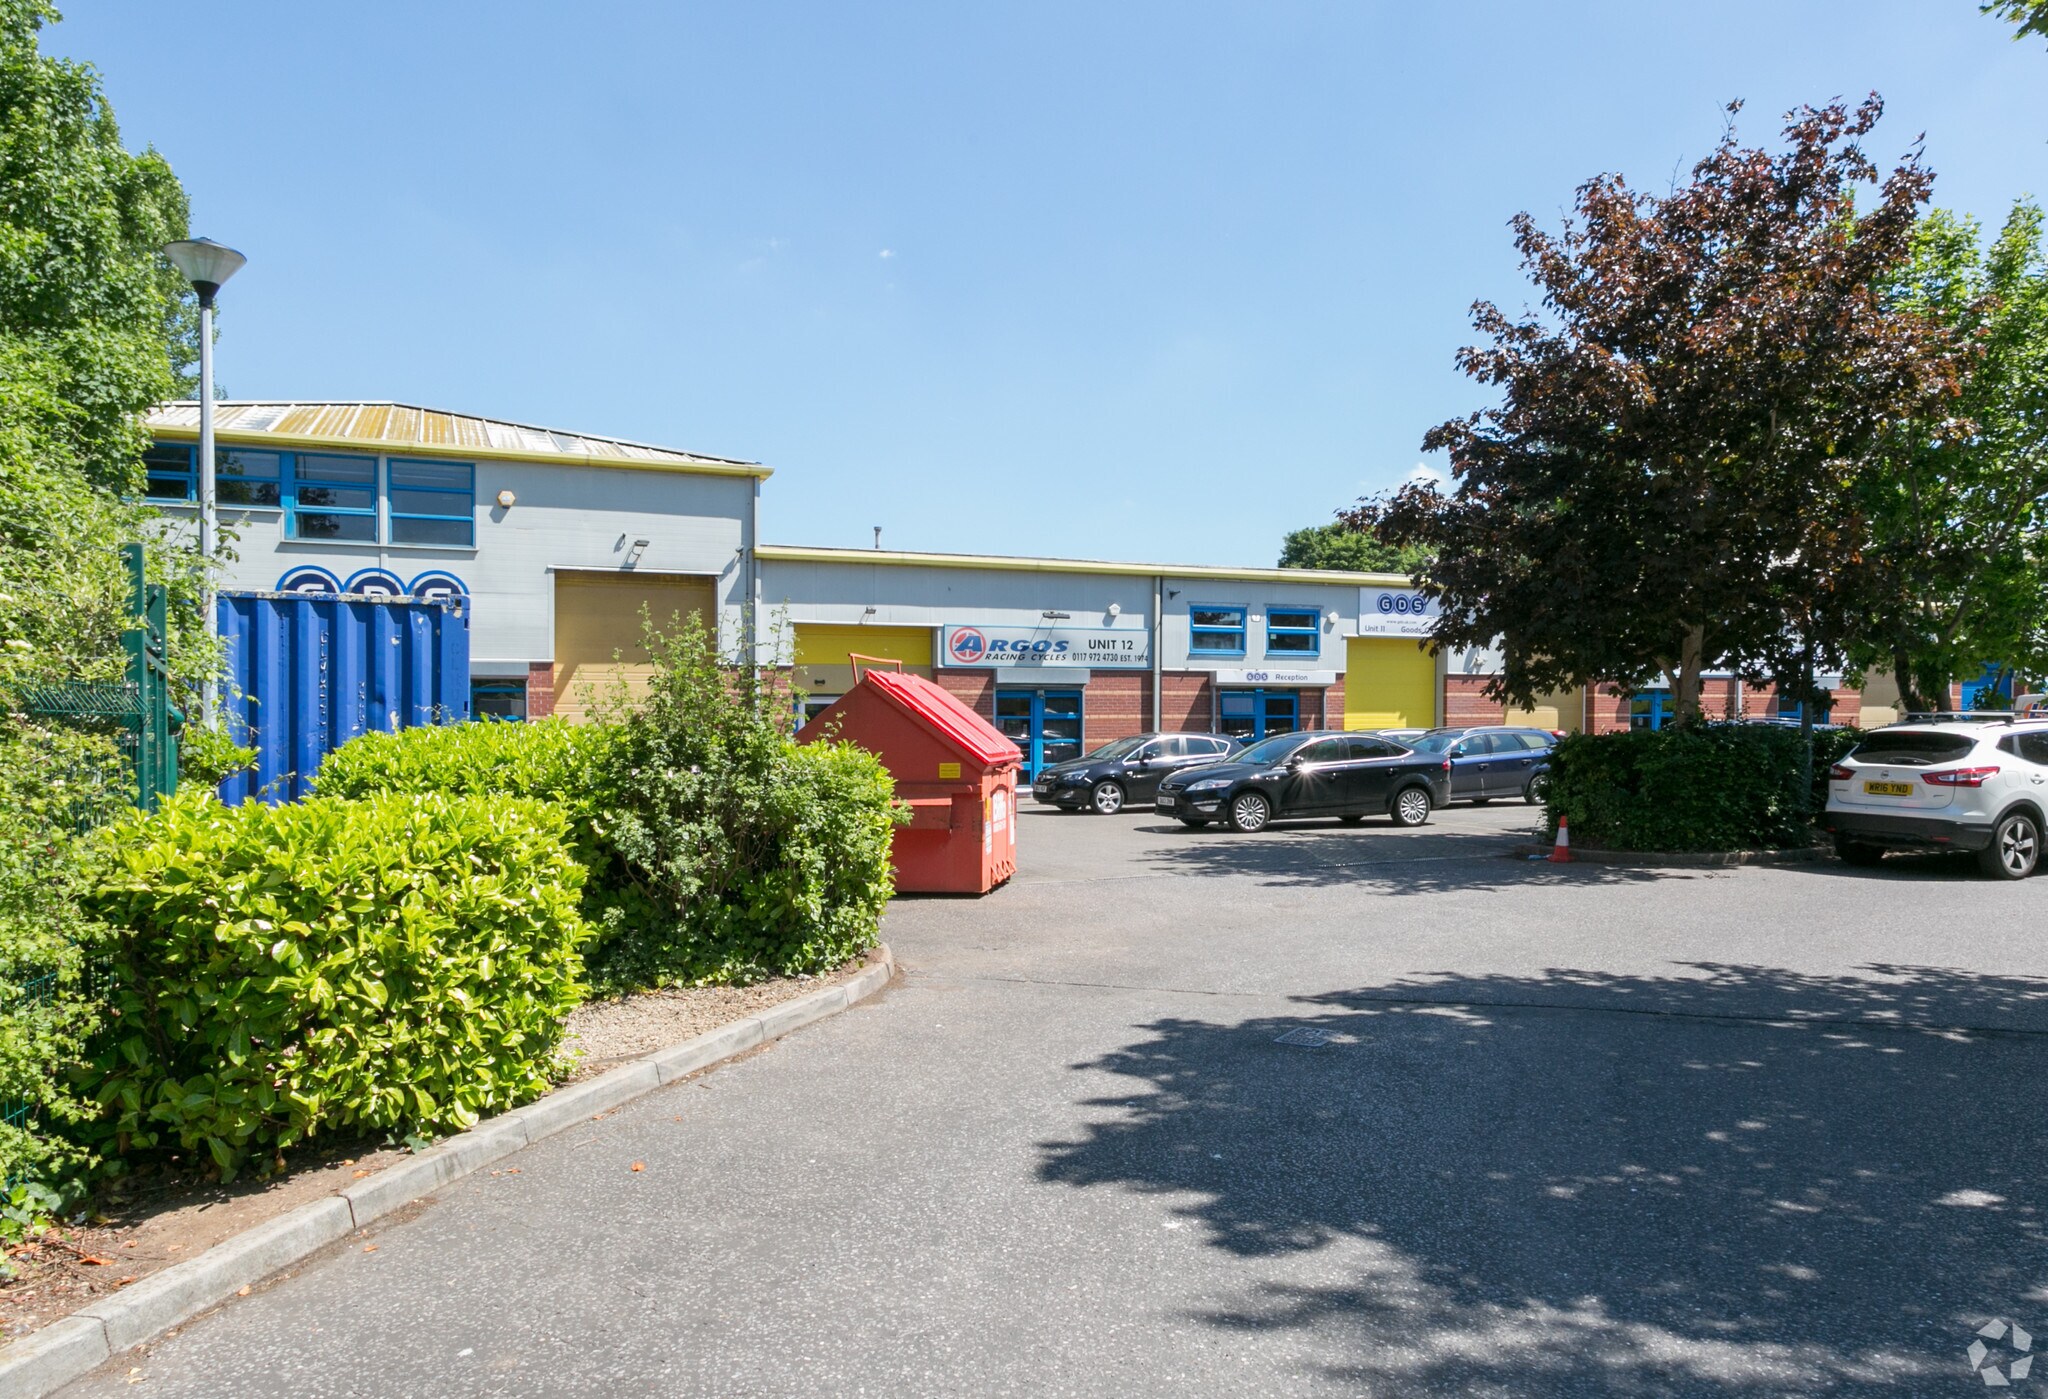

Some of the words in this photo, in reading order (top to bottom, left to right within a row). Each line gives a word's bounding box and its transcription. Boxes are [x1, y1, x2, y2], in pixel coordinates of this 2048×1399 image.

[1380, 598, 1423, 612] GDS
[953, 635, 1070, 652] ARGOS
[1088, 639, 1117, 650] UNIT
[1121, 640, 1133, 650] 12
[985, 653, 1025, 661] RACING
[1030, 653, 1067, 661] CYCLES
[1072, 653, 1087, 661] 0117
[1088, 653, 1101, 661] 972
[1102, 653, 1118, 662] 4730
[1120, 654, 1132, 662] EST.
[1275, 674, 1308, 682] Reception
[1868, 783, 1888, 791] WR16
[1890, 785, 1908, 793] YND
